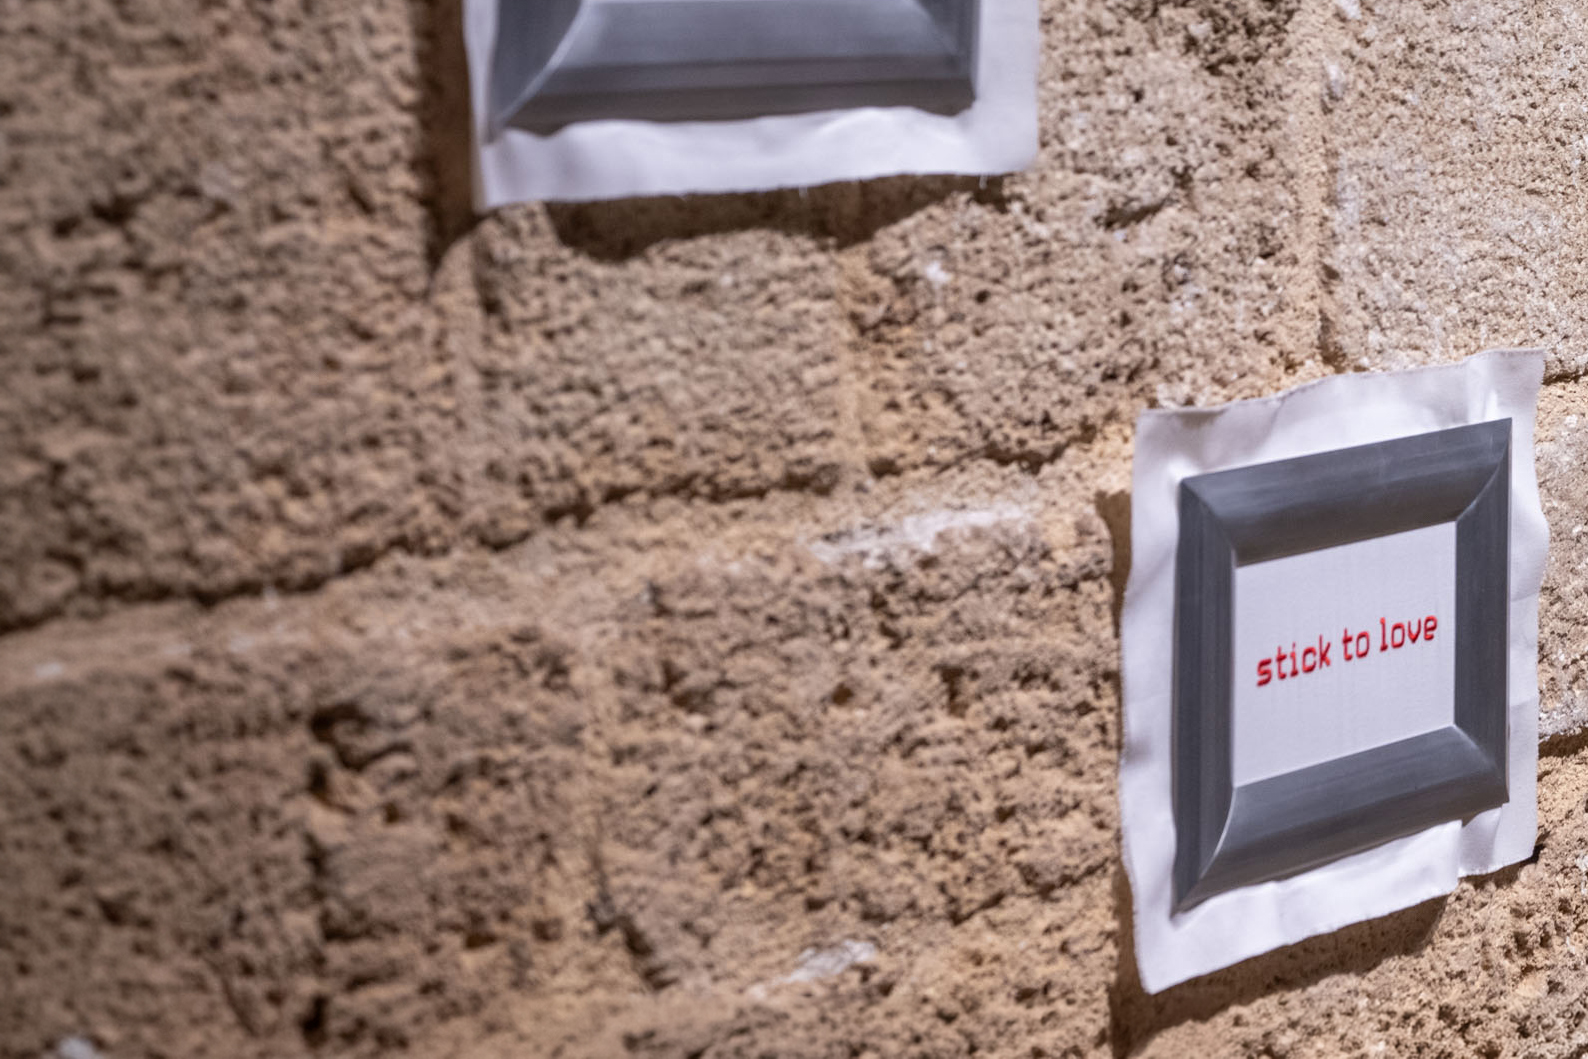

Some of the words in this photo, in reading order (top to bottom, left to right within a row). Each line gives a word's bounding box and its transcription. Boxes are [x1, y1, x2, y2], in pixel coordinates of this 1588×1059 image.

[1256, 635, 1332, 687] stick
[1341, 628, 1371, 662] to
[1379, 615, 1438, 652] love
